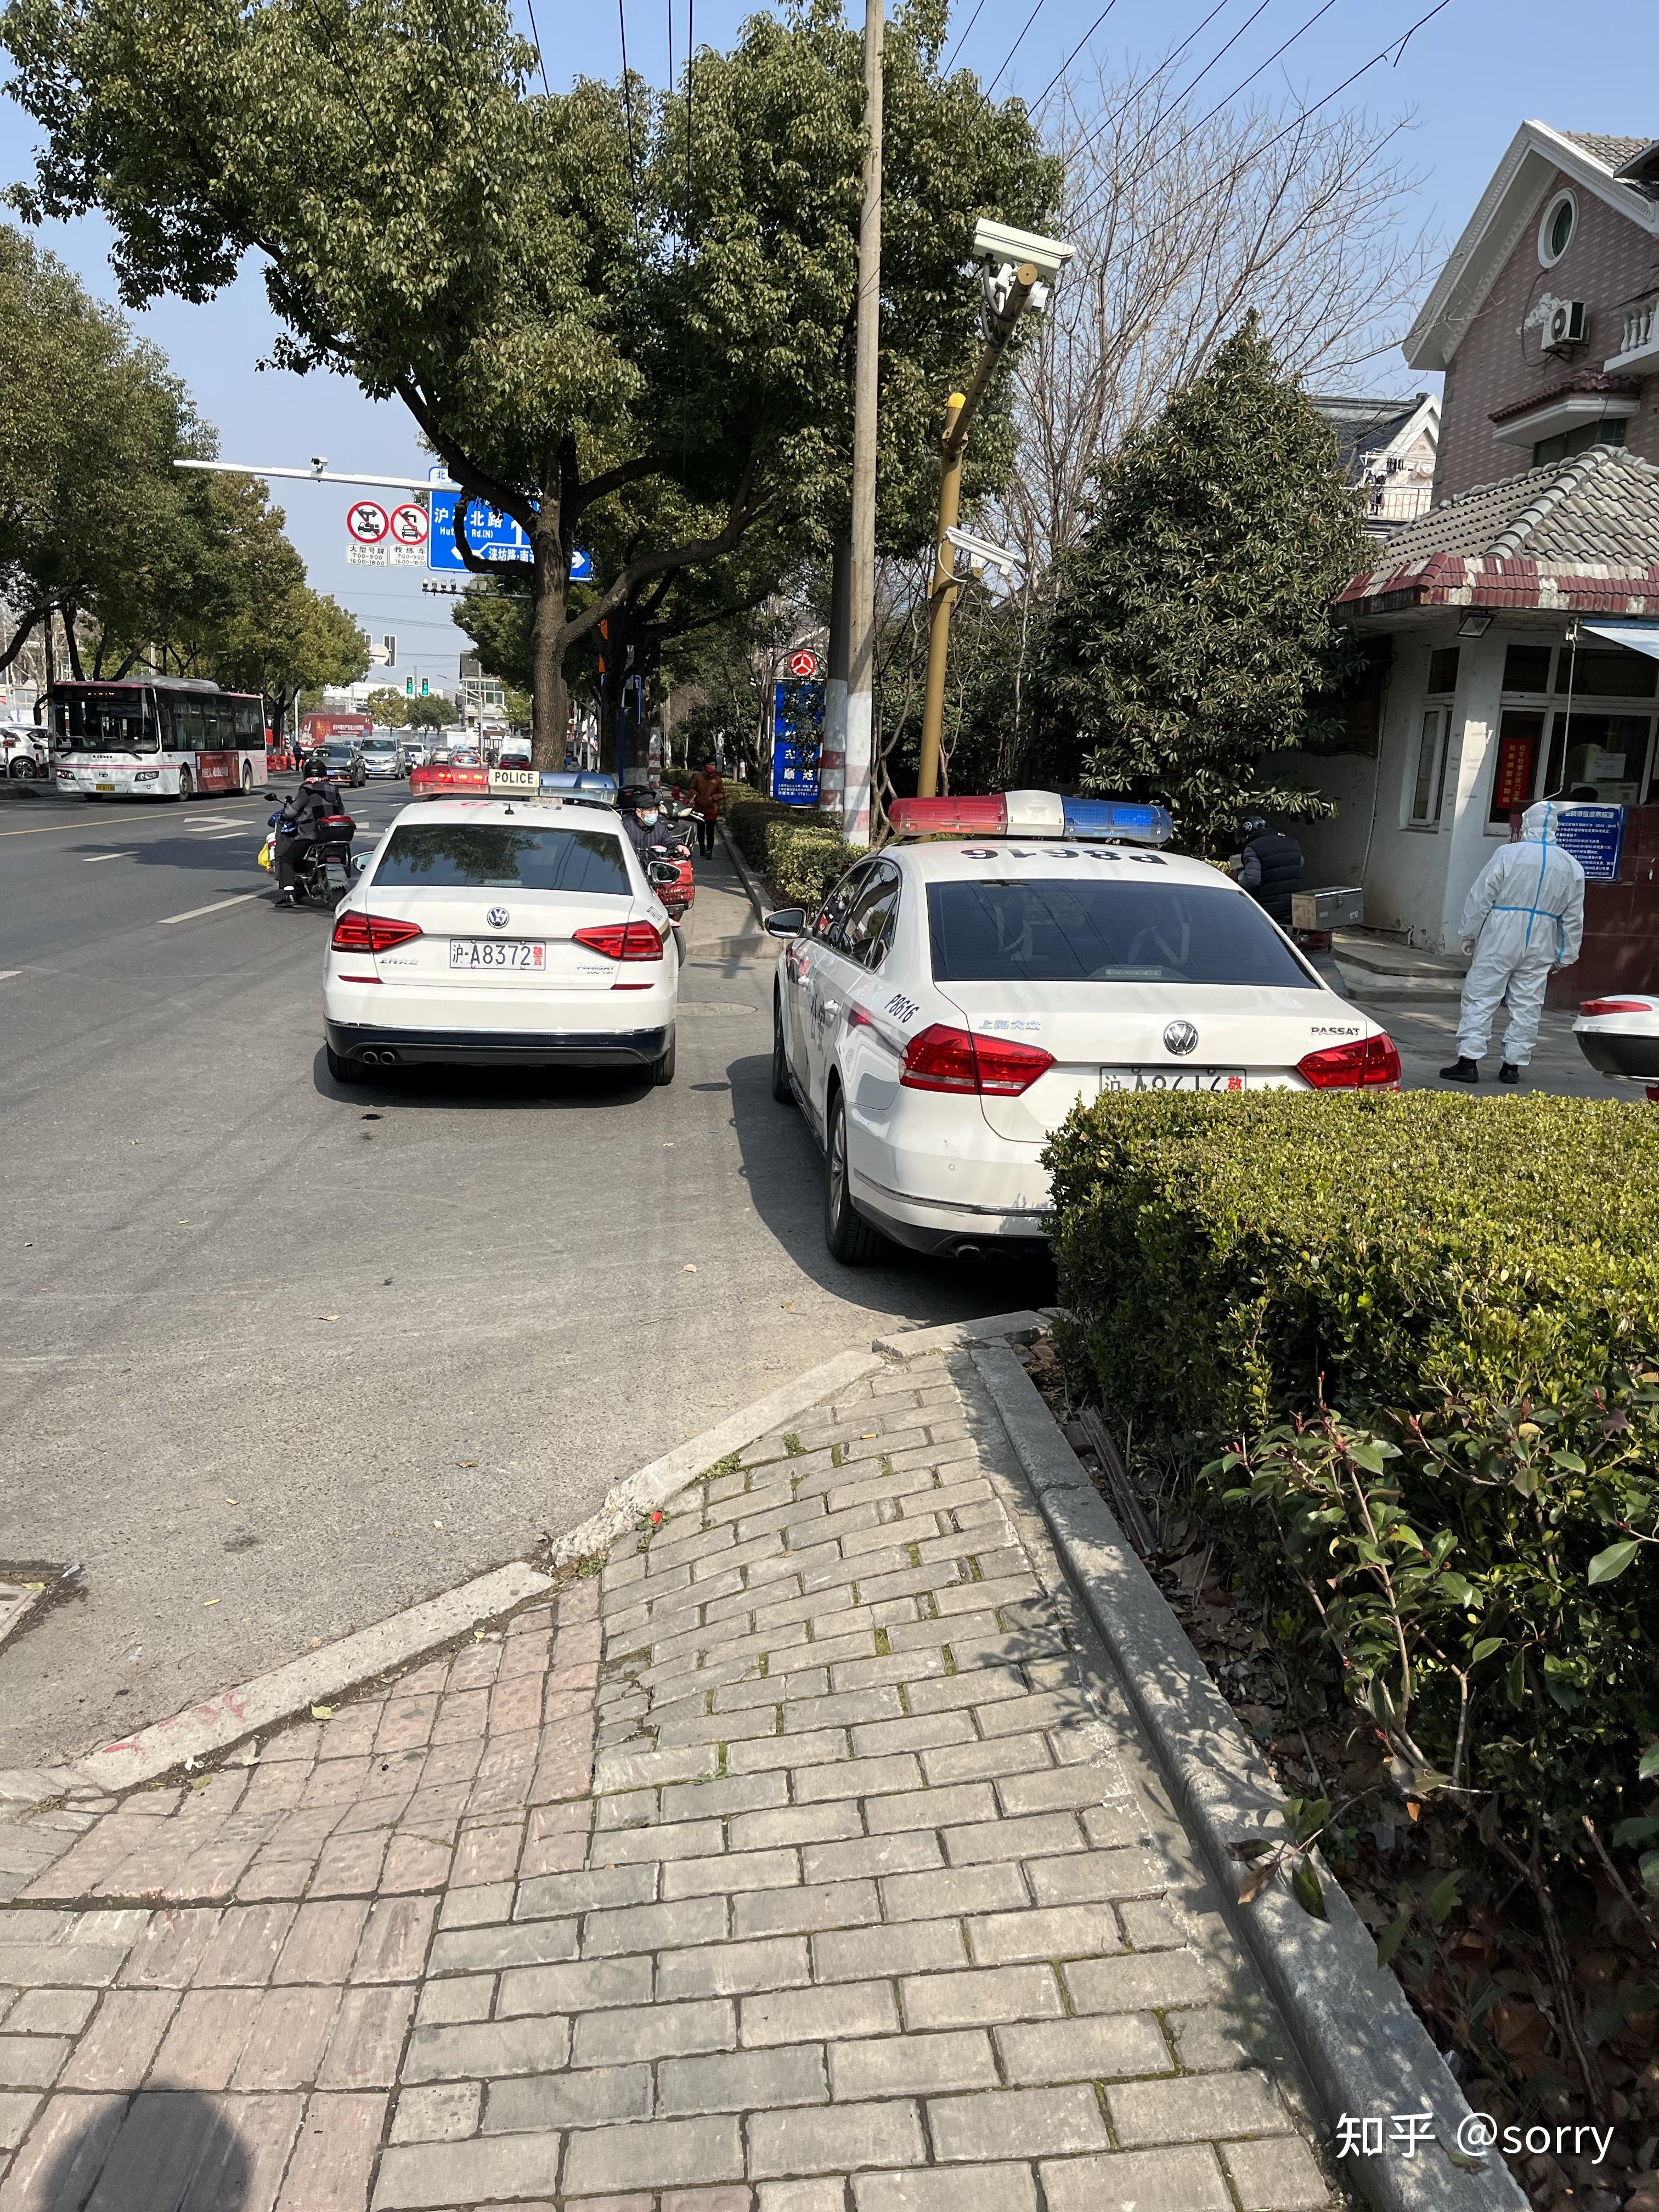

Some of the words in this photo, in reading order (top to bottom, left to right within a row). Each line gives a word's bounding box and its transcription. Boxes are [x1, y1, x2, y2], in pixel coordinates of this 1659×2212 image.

[436, 470, 446, 480] 北
[434, 507, 503, 528] 沪北路
[349, 545, 385, 555] 大型号牌
[394, 546, 426, 555] 教练车
[495, 771, 534, 784] POLICE
[960, 848, 1168, 865] P8616
[884, 993, 920, 1023] P8616
[978, 1020, 1041, 1030] 上海大众
[1310, 1026, 1360, 1036] PASSAT
